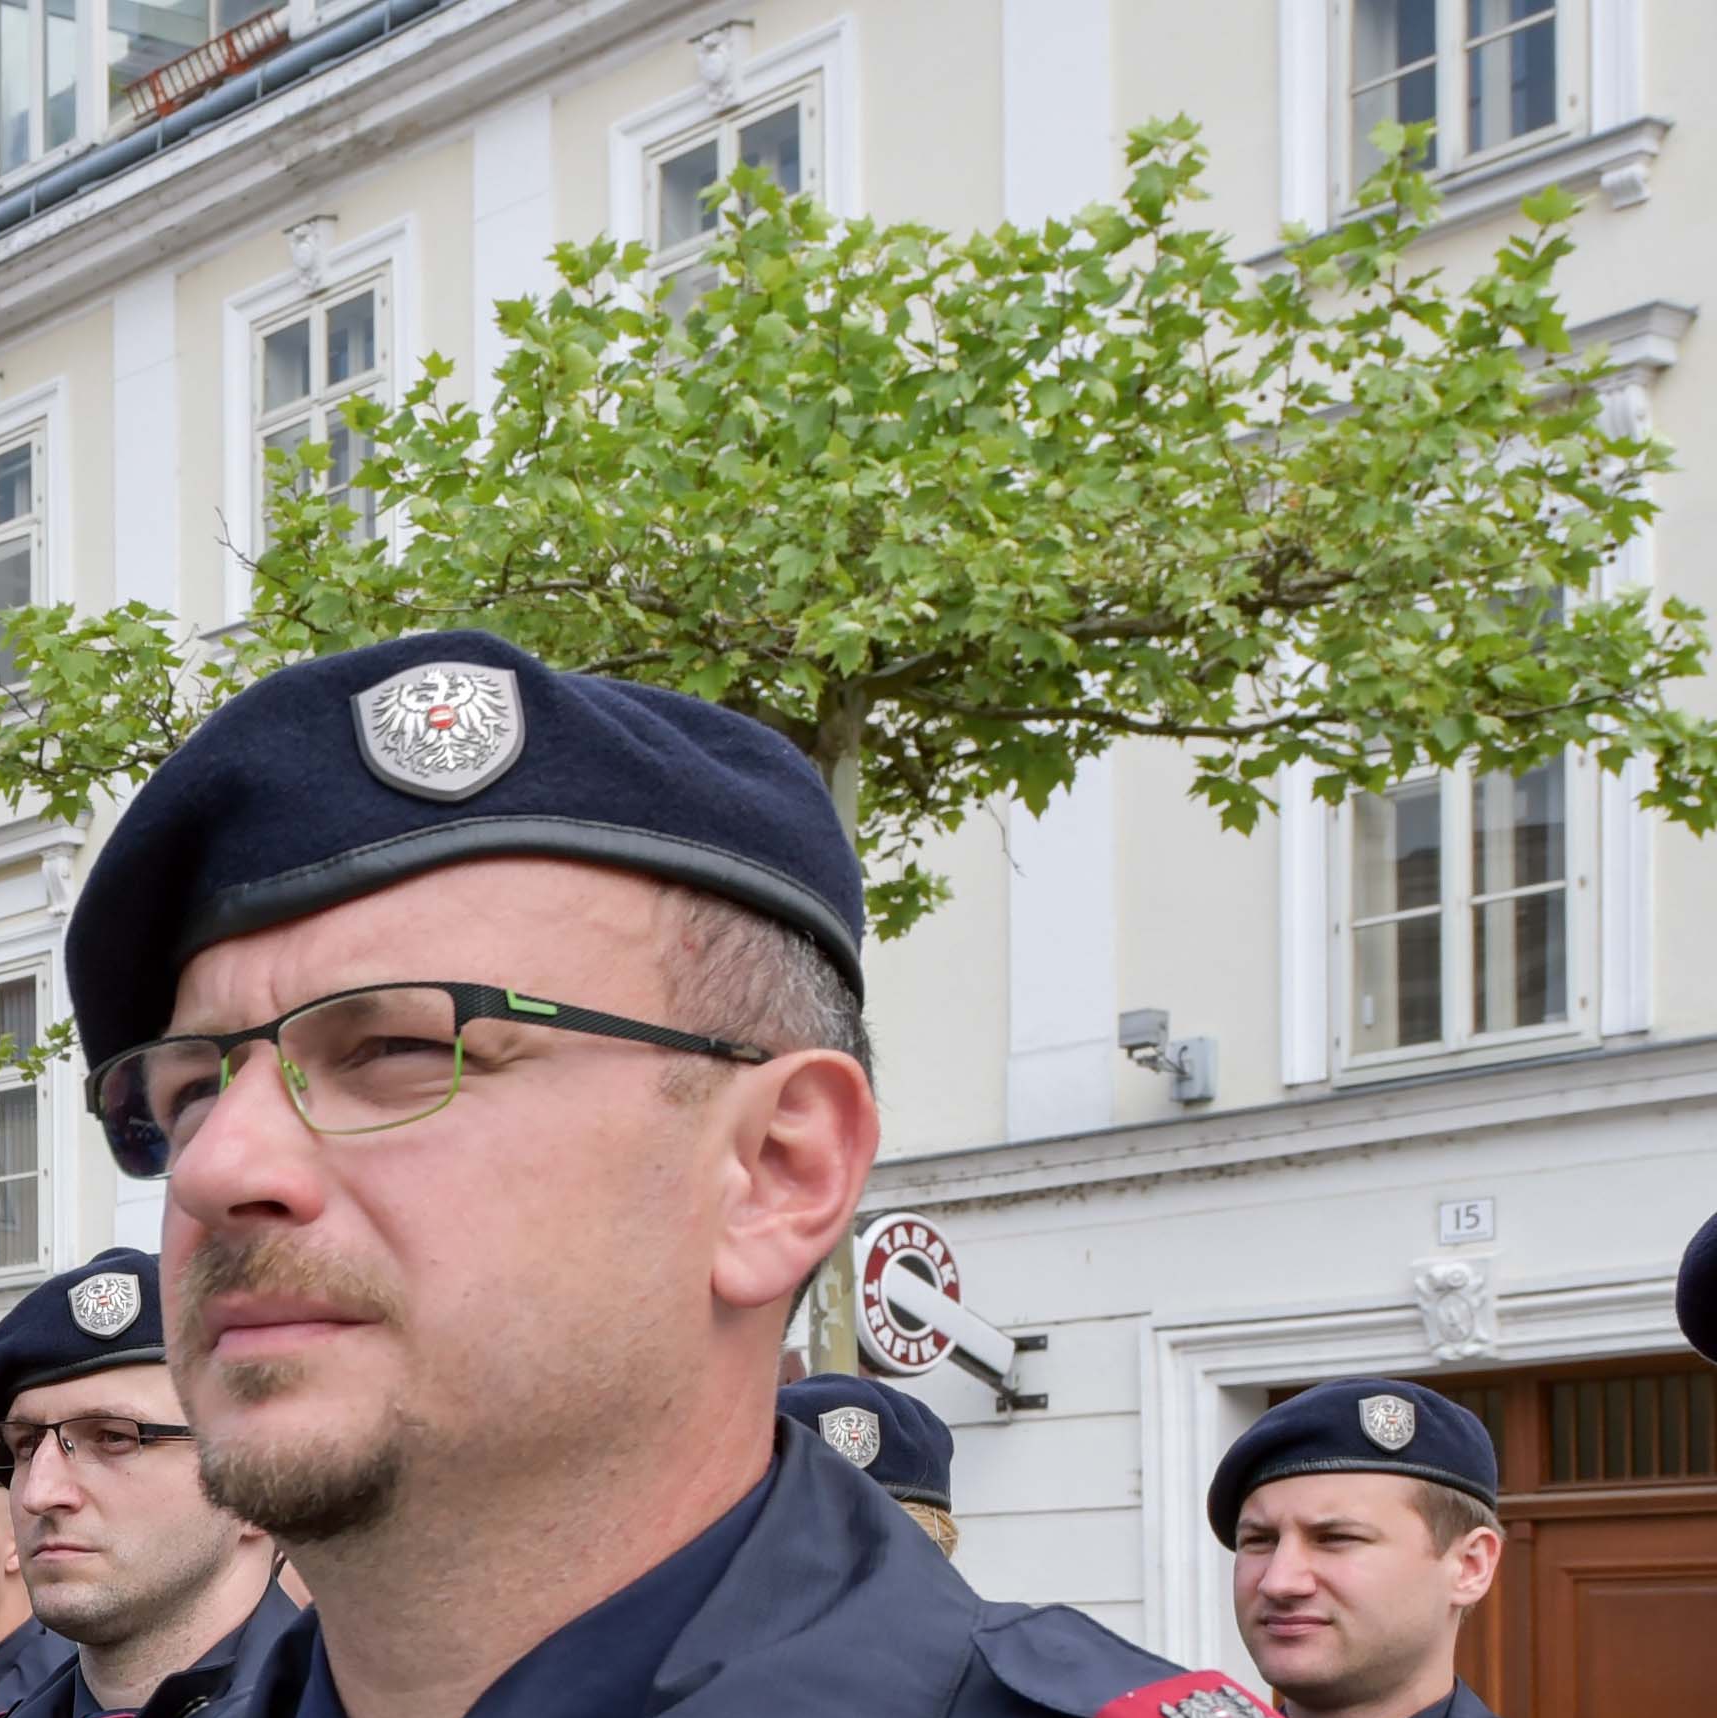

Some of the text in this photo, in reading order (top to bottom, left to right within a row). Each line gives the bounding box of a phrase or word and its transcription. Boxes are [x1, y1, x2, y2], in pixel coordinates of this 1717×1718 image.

[1454, 1204, 1480, 1231] 15
[877, 1224, 958, 1288] TABAK
[864, 1279, 939, 1363] TRAFIK
